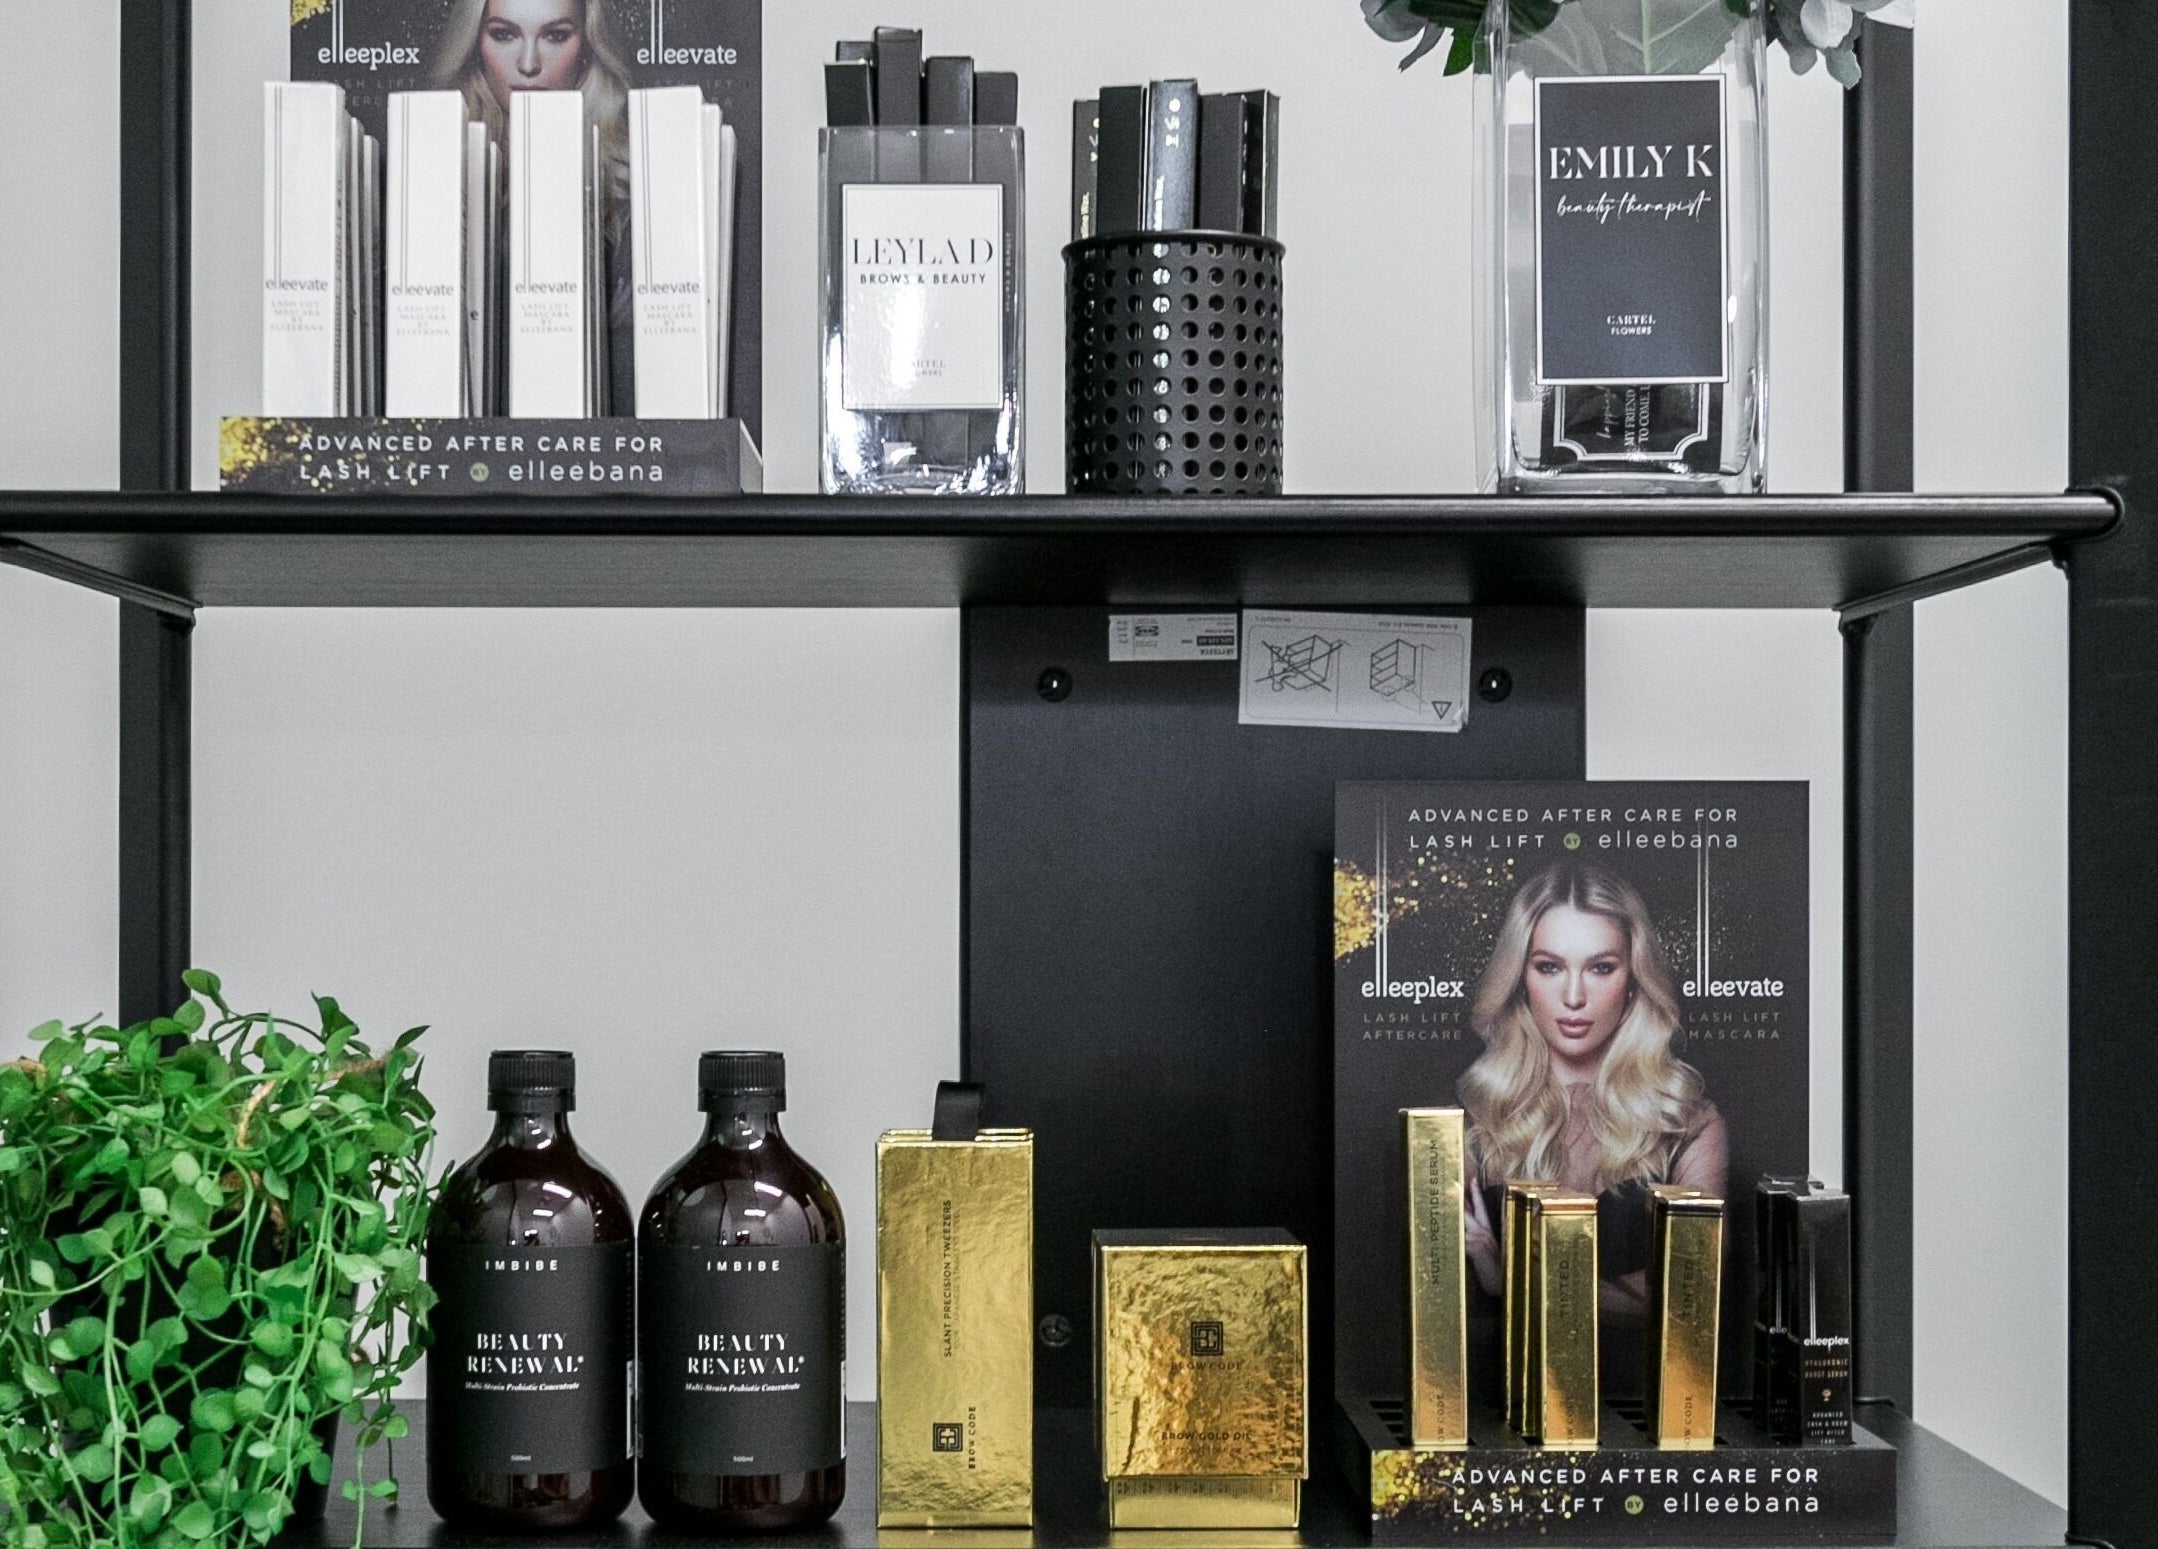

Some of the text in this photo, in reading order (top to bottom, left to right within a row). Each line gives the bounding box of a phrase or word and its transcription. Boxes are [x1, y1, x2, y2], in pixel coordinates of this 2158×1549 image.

[1548, 144, 1715, 180] EMILY K
[1556, 189, 1712, 224] beauty therapist
[860, 273, 987, 285] BROWS & BEAUTY
[1606, 314, 1657, 325] CARTEL
[1610, 325, 1652, 336] FLOWERS
[299, 435, 664, 452] ADVANCED AFTER CARE FOR
[300, 464, 371, 480] LASH
[387, 464, 450, 481] LIFT
[508, 461, 664, 482] elleebana
[1408, 808, 1738, 823] ADVANCED AFTER CARE FOR
[1410, 834, 1473, 849] LASH
[1490, 834, 1546, 849] LIFT
[1598, 830, 1739, 849] elleebana
[1363, 1012, 1461, 1024] LASH LIFT
[1688, 1011, 1781, 1023] LASH LIFT
[1362, 1029, 1463, 1041] AFTERCARE
[1688, 1029, 1781, 1040] MASCARA
[1429, 1139, 1439, 1185] SERUM
[485, 1259, 558, 1272] IMBIBE
[706, 1260, 780, 1272] IMBIBE
[942, 1199, 952, 1358] SLANT PRECISION TWEEZERS
[1558, 1259, 1569, 1320] TINTED
[1682, 1259, 1693, 1318] TINTED
[477, 1333, 566, 1351] BEAUTY
[697, 1333, 788, 1351] BEAUTY
[968, 1406, 976, 1470] BROW CODE
[1161, 1431, 1195, 1440] BROW
[1198, 1431, 1230, 1440] GOLD
[1452, 1468, 1819, 1485] ADVANCED AFTER CARE FOR
[1453, 1497, 1524, 1513] LASH
[1543, 1497, 1603, 1513] LIFT
[1663, 1492, 1820, 1513] elleebana
